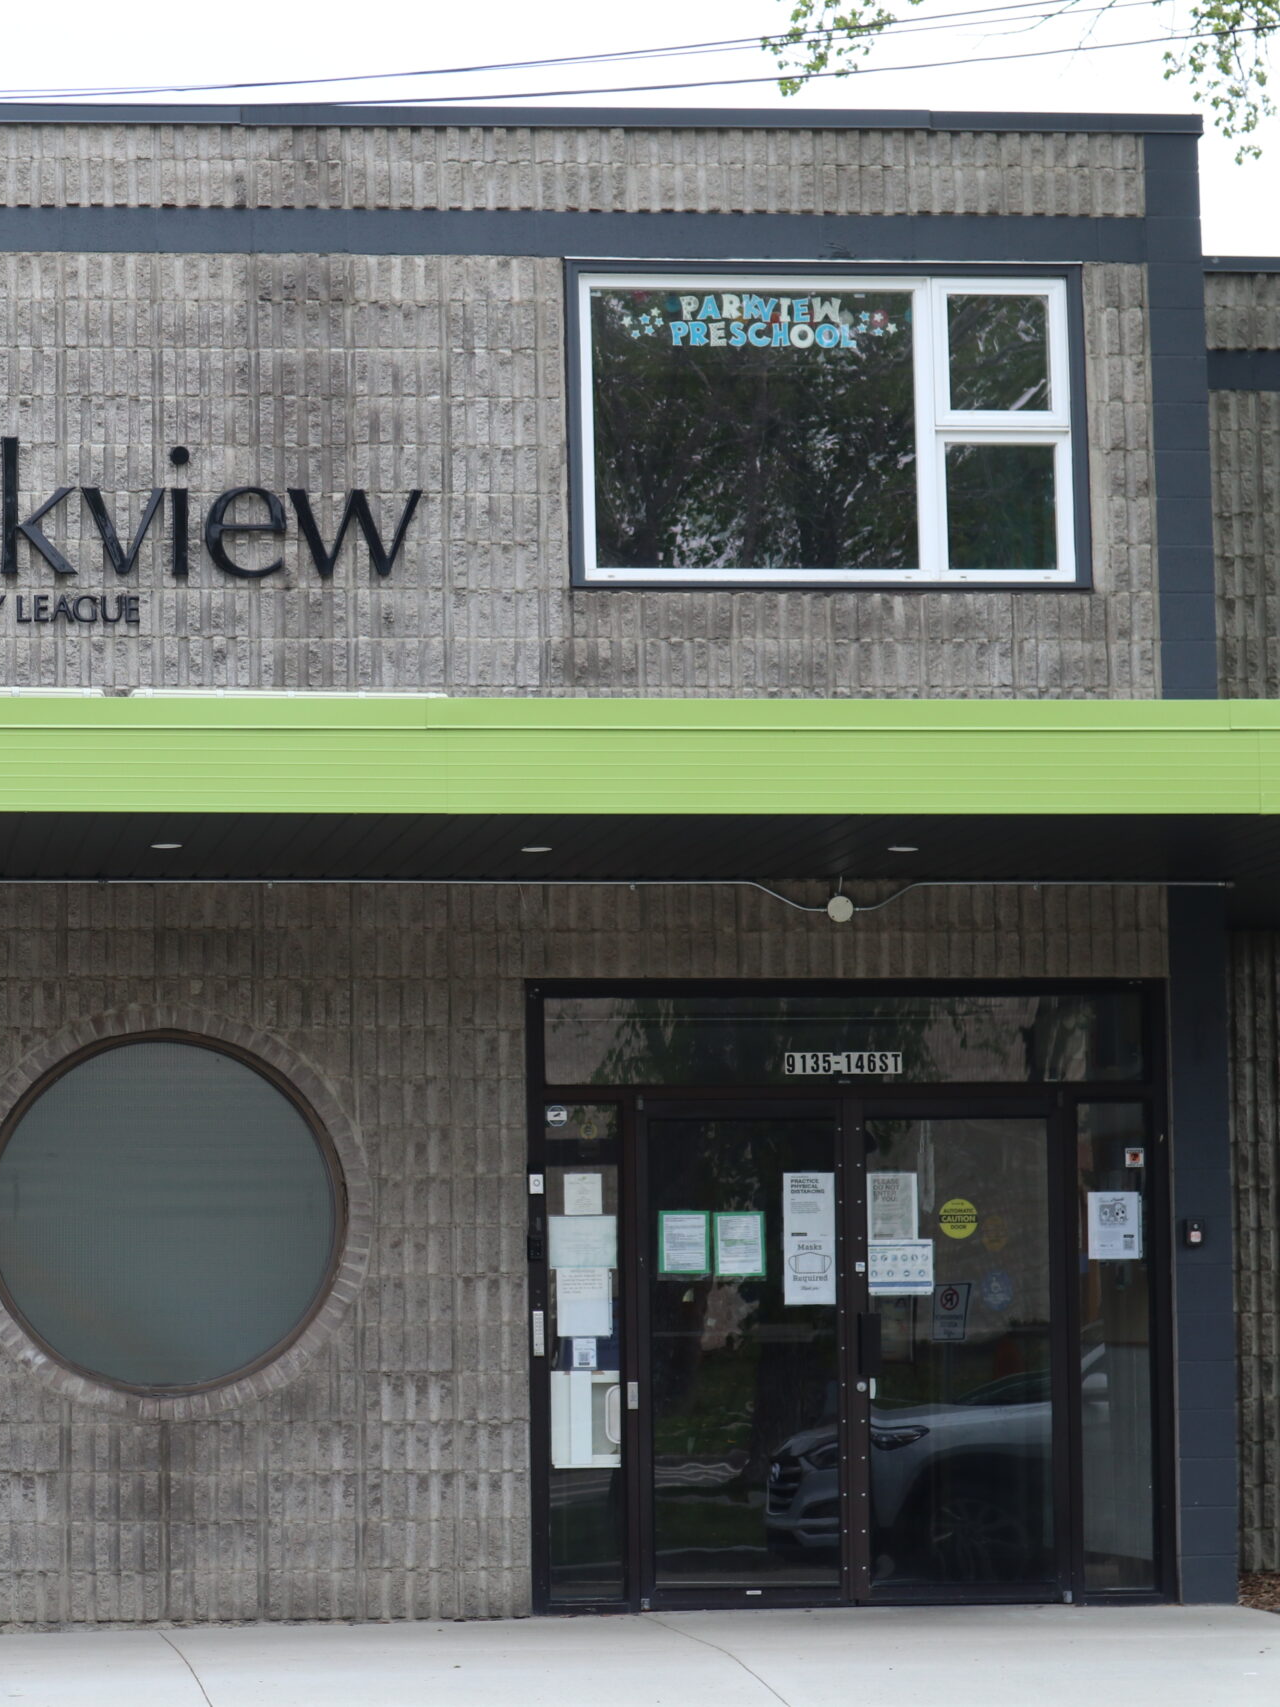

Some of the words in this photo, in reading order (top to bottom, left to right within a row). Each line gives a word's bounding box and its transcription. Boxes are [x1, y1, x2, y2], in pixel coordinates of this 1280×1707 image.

[680, 294, 841, 322] PARKVIEW
[670, 321, 857, 348] PRESCHOOL
[16, 595, 141, 624] LEAGUE
[941, 1215, 976, 1223] CAUTION
[797, 1243, 823, 1251] Masks
[792, 1274, 829, 1283] Required
